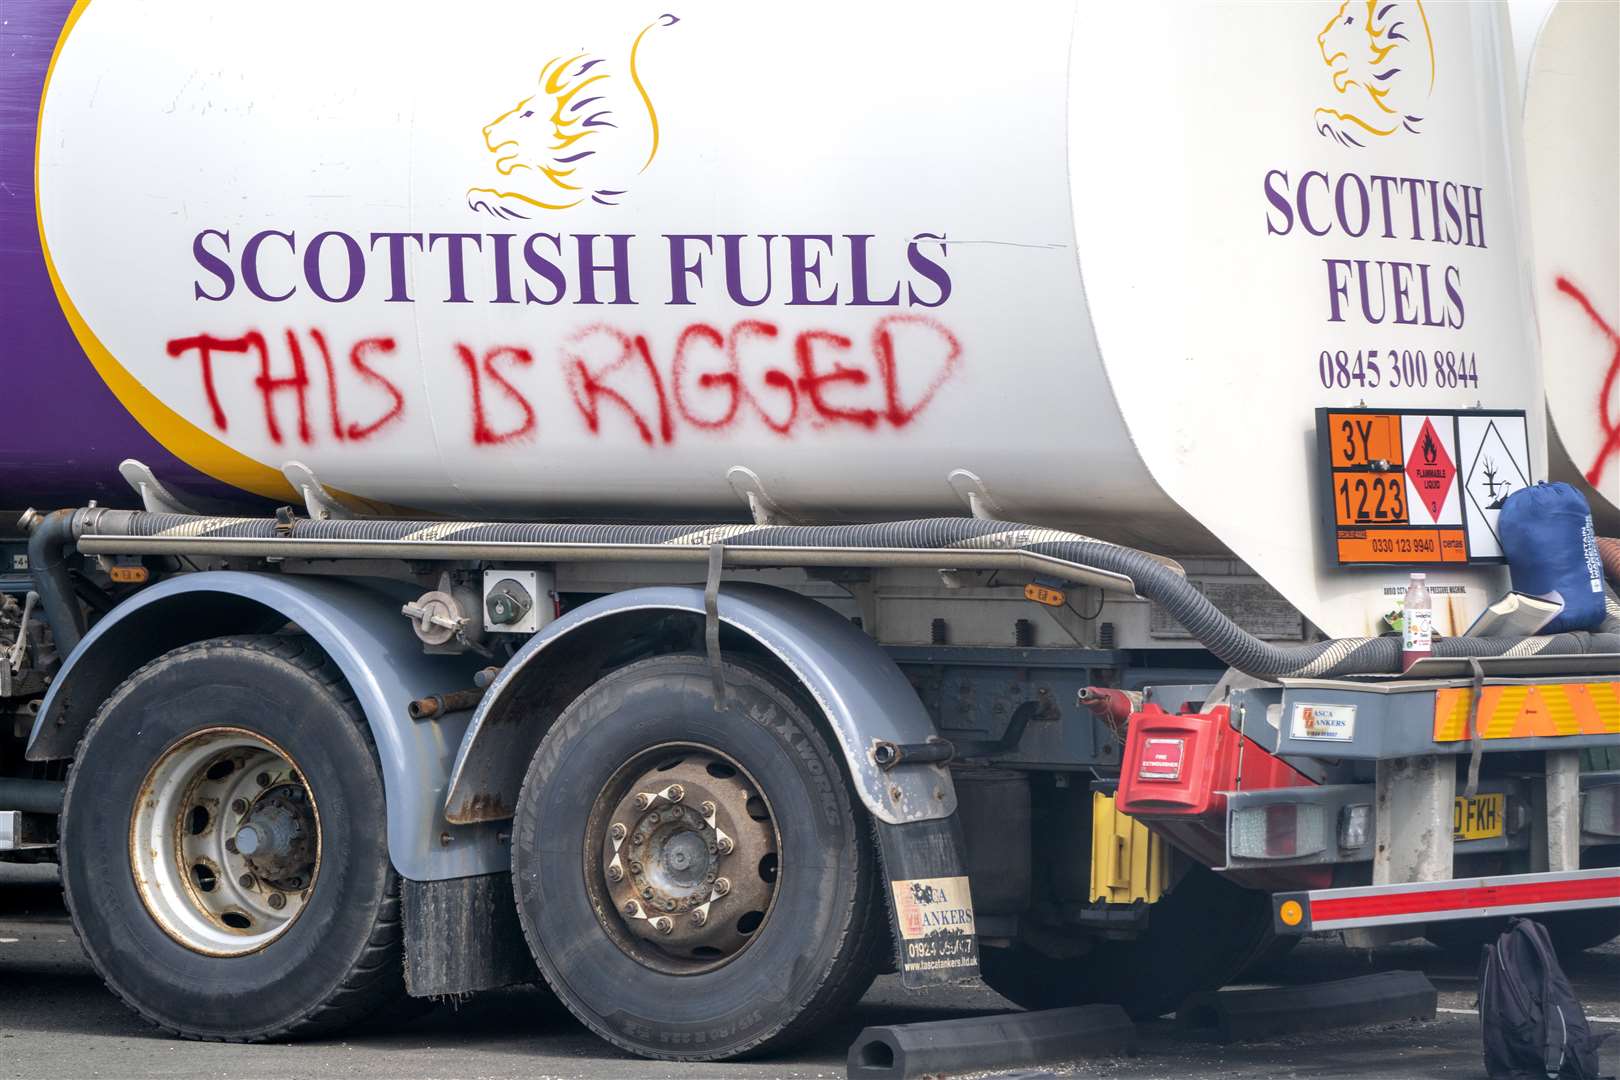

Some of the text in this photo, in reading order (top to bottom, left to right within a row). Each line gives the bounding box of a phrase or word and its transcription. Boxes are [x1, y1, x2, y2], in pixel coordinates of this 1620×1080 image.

[1263, 169, 1489, 249] SCOTTISH
[192, 228, 953, 308] SCOTTISH FUELS
[1321, 258, 1466, 331] FUELS
[165, 312, 964, 447] THIS IS RIGGED
[1318, 349, 1480, 389] 0845 300 8844
[1340, 419, 1374, 463] 3Y
[1415, 468, 1447, 479] FLAMMABLE
[1423, 480, 1441, 490] LIQUID
[1339, 477, 1404, 520] 1223
[1431, 500, 1438, 514] 3
[1371, 537, 1435, 553] 0330 123 9940
[1581, 526, 1595, 580] MOUNTAIN
[1466, 796, 1497, 833] FKH
